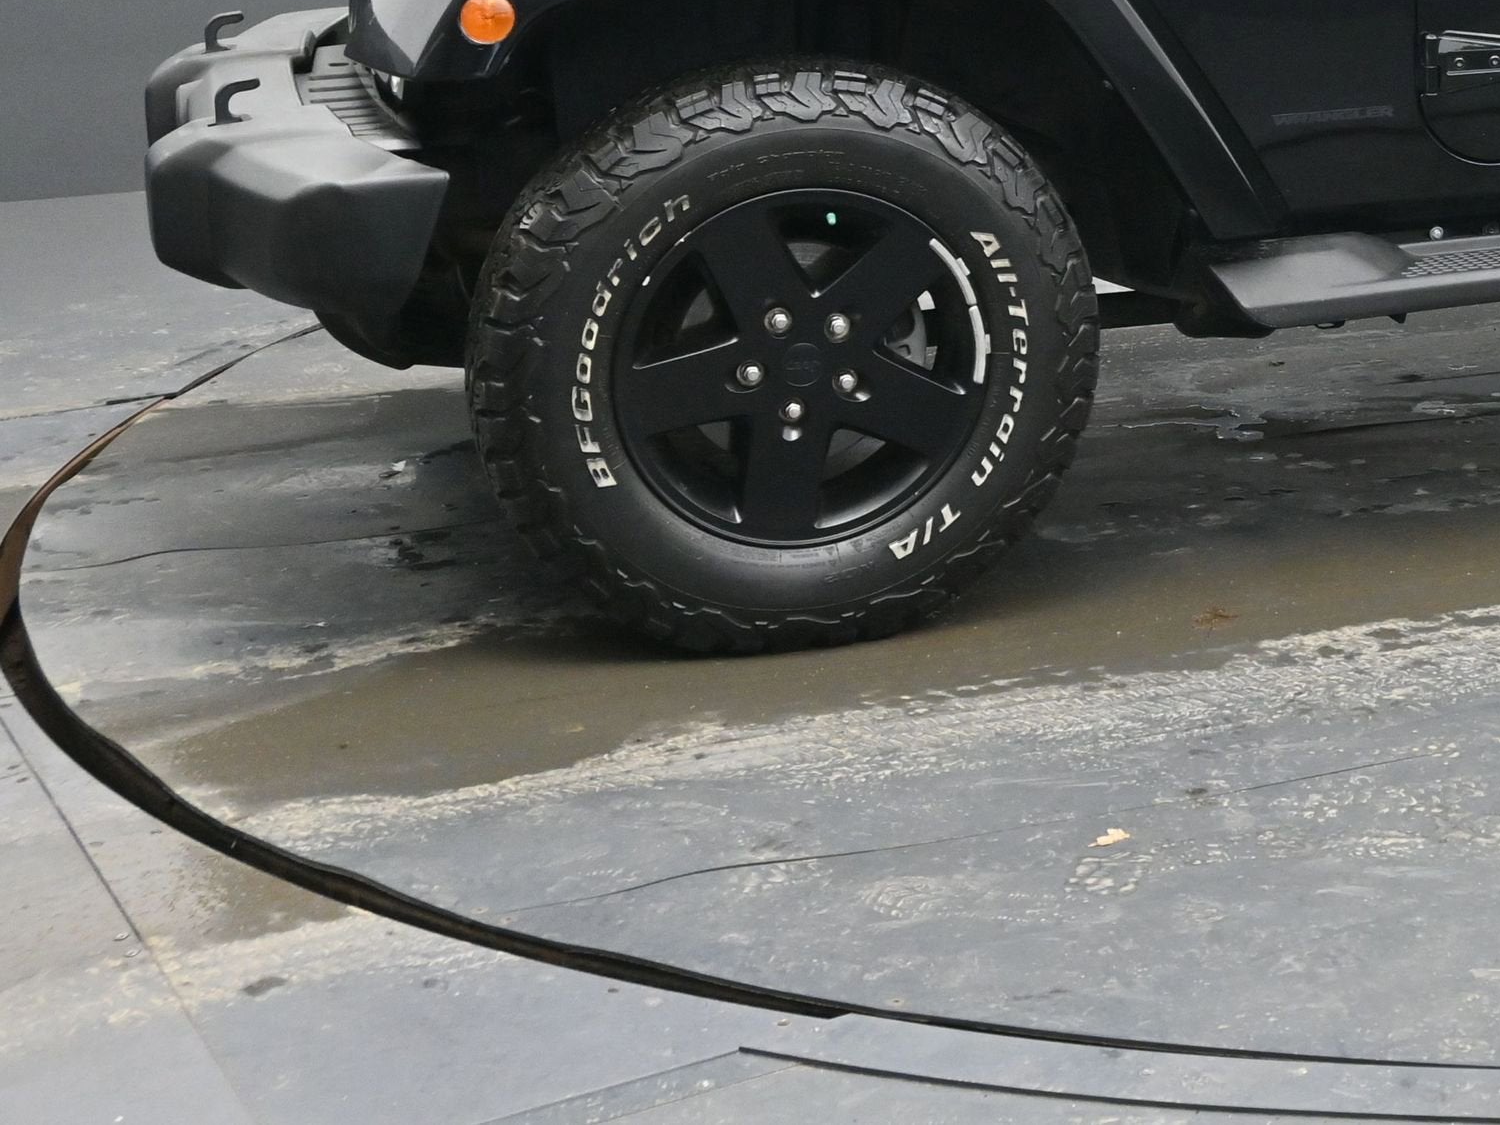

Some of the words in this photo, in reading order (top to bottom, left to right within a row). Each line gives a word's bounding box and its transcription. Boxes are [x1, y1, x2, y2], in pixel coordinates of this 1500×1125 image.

[571, 195, 691, 488] BFGoodrich
[970, 231, 1029, 487] All-Terrain
[889, 502, 961, 560] T/A
